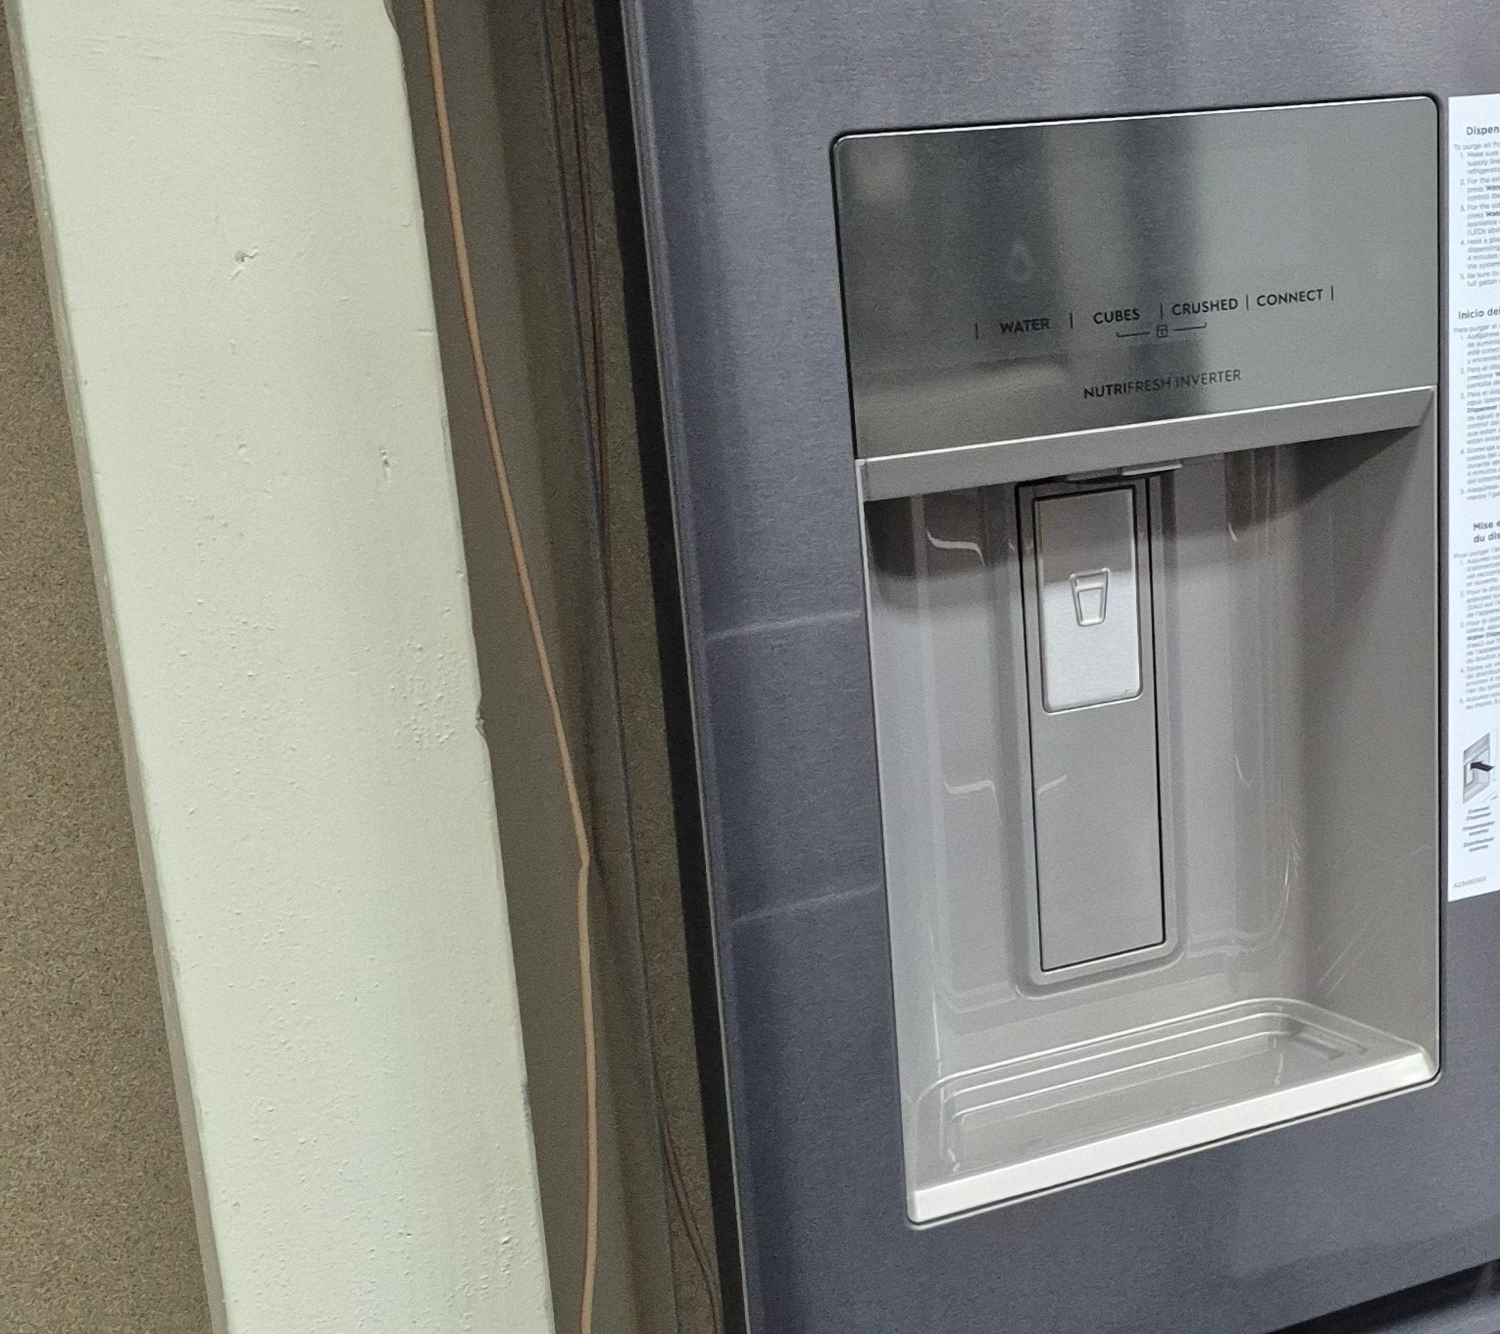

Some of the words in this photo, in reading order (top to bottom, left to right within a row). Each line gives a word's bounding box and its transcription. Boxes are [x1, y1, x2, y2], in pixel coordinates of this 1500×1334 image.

[999, 317, 1051, 334] WATER
[1093, 307, 1141, 325] CUBES
[1171, 297, 1239, 316] CRUSHED
[1256, 288, 1324, 307] CONNECT
[1458, 309, 1484, 319] Inicio
[1083, 378, 1171, 399] NUTRIFRESH
[1175, 368, 1242, 390] INVERTER
[1473, 522, 1493, 530] Mise
[1473, 535, 1485, 543] du
